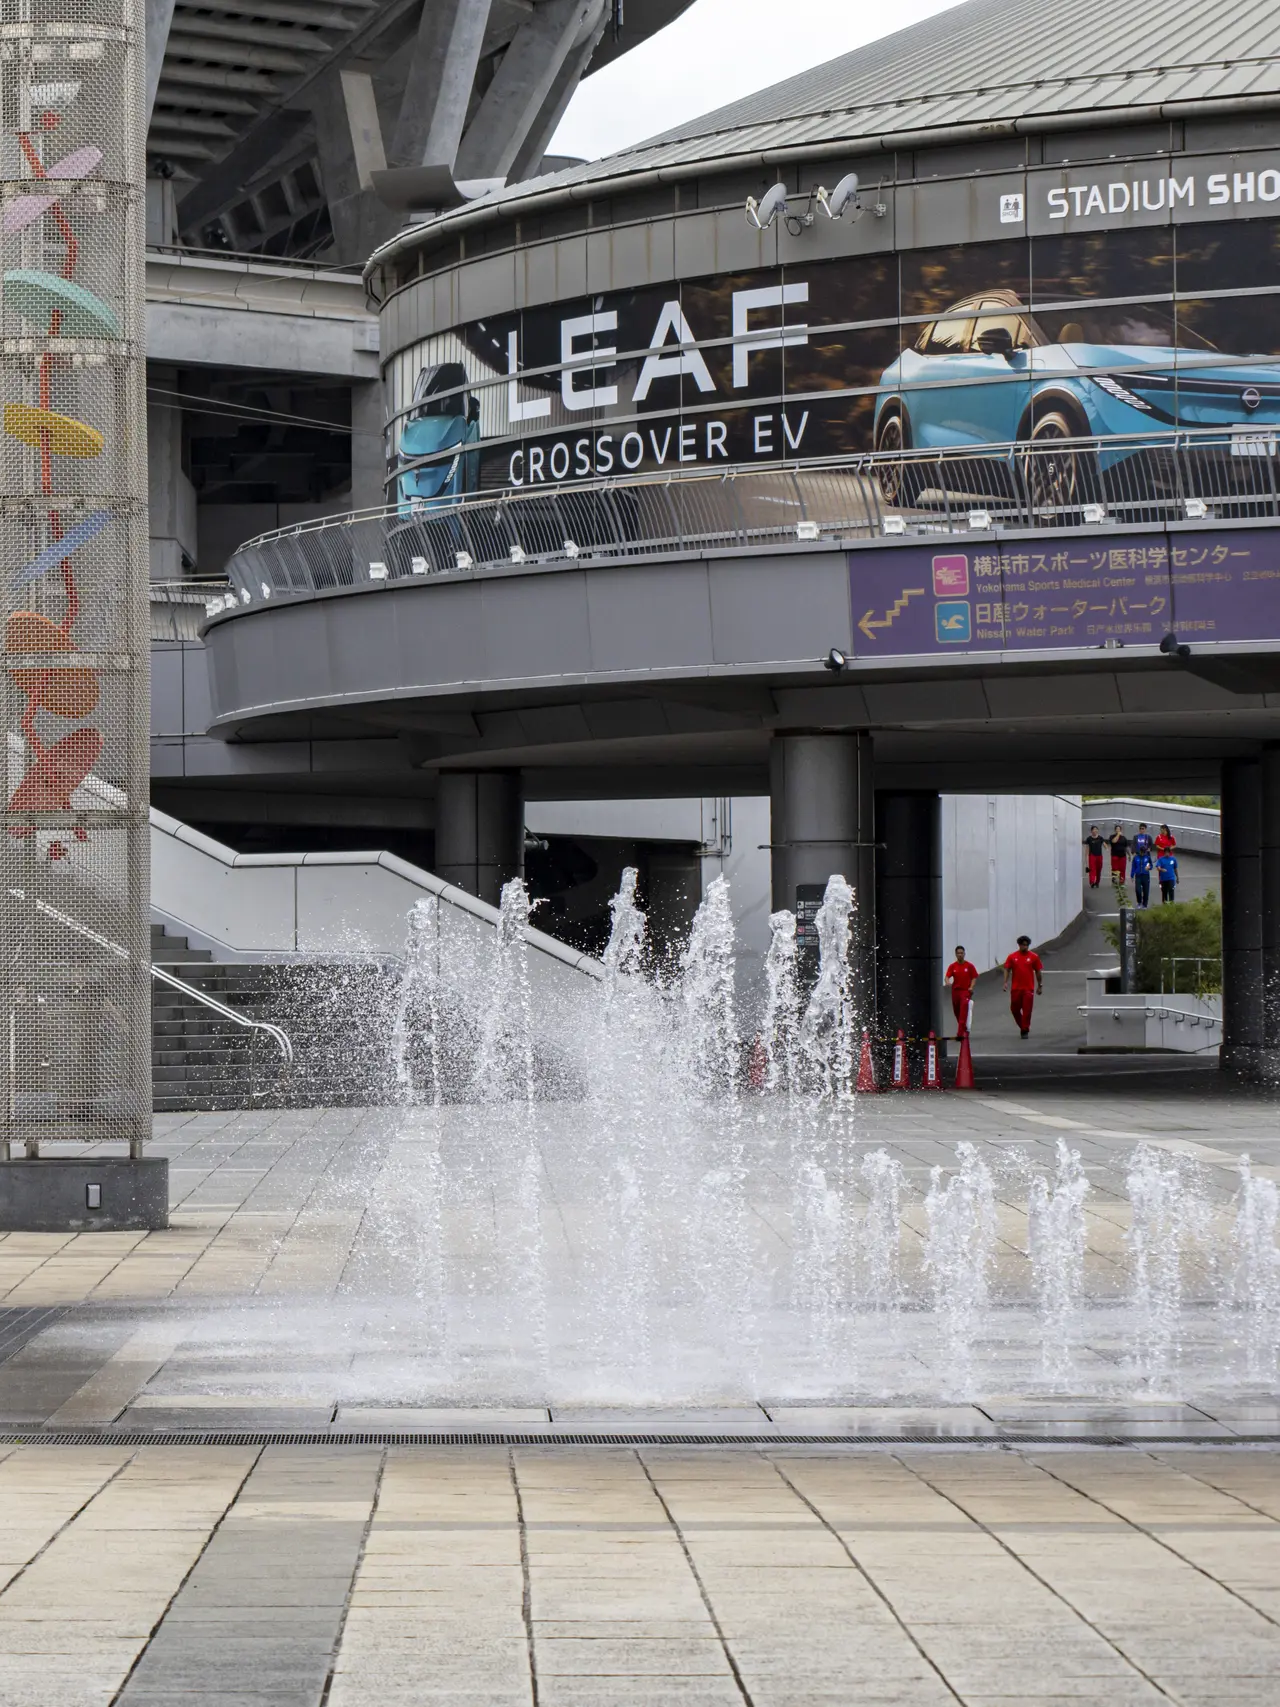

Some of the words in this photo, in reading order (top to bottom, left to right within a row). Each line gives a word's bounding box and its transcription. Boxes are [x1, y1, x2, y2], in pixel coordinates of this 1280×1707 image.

[1047, 176, 1195, 219] STADIUM
[1207, 169, 1280, 205] SHO
[508, 282, 809, 423] LEAF
[509, 421, 729, 486] CROSSOVER
[754, 411, 809, 453] EV
[974, 545, 1251, 577] 横浜市スポーツ医科学センター
[976, 583, 1025, 593] Yokohama
[1028, 580, 1060, 592] Sports
[1063, 578, 1100, 589] Medical
[1103, 577, 1135, 587] Center
[975, 596, 1166, 624] 日産ウォーターパーク
[976, 628, 1012, 639] Nissan
[1016, 627, 1046, 637] Water
[1050, 625, 1074, 636] Park
